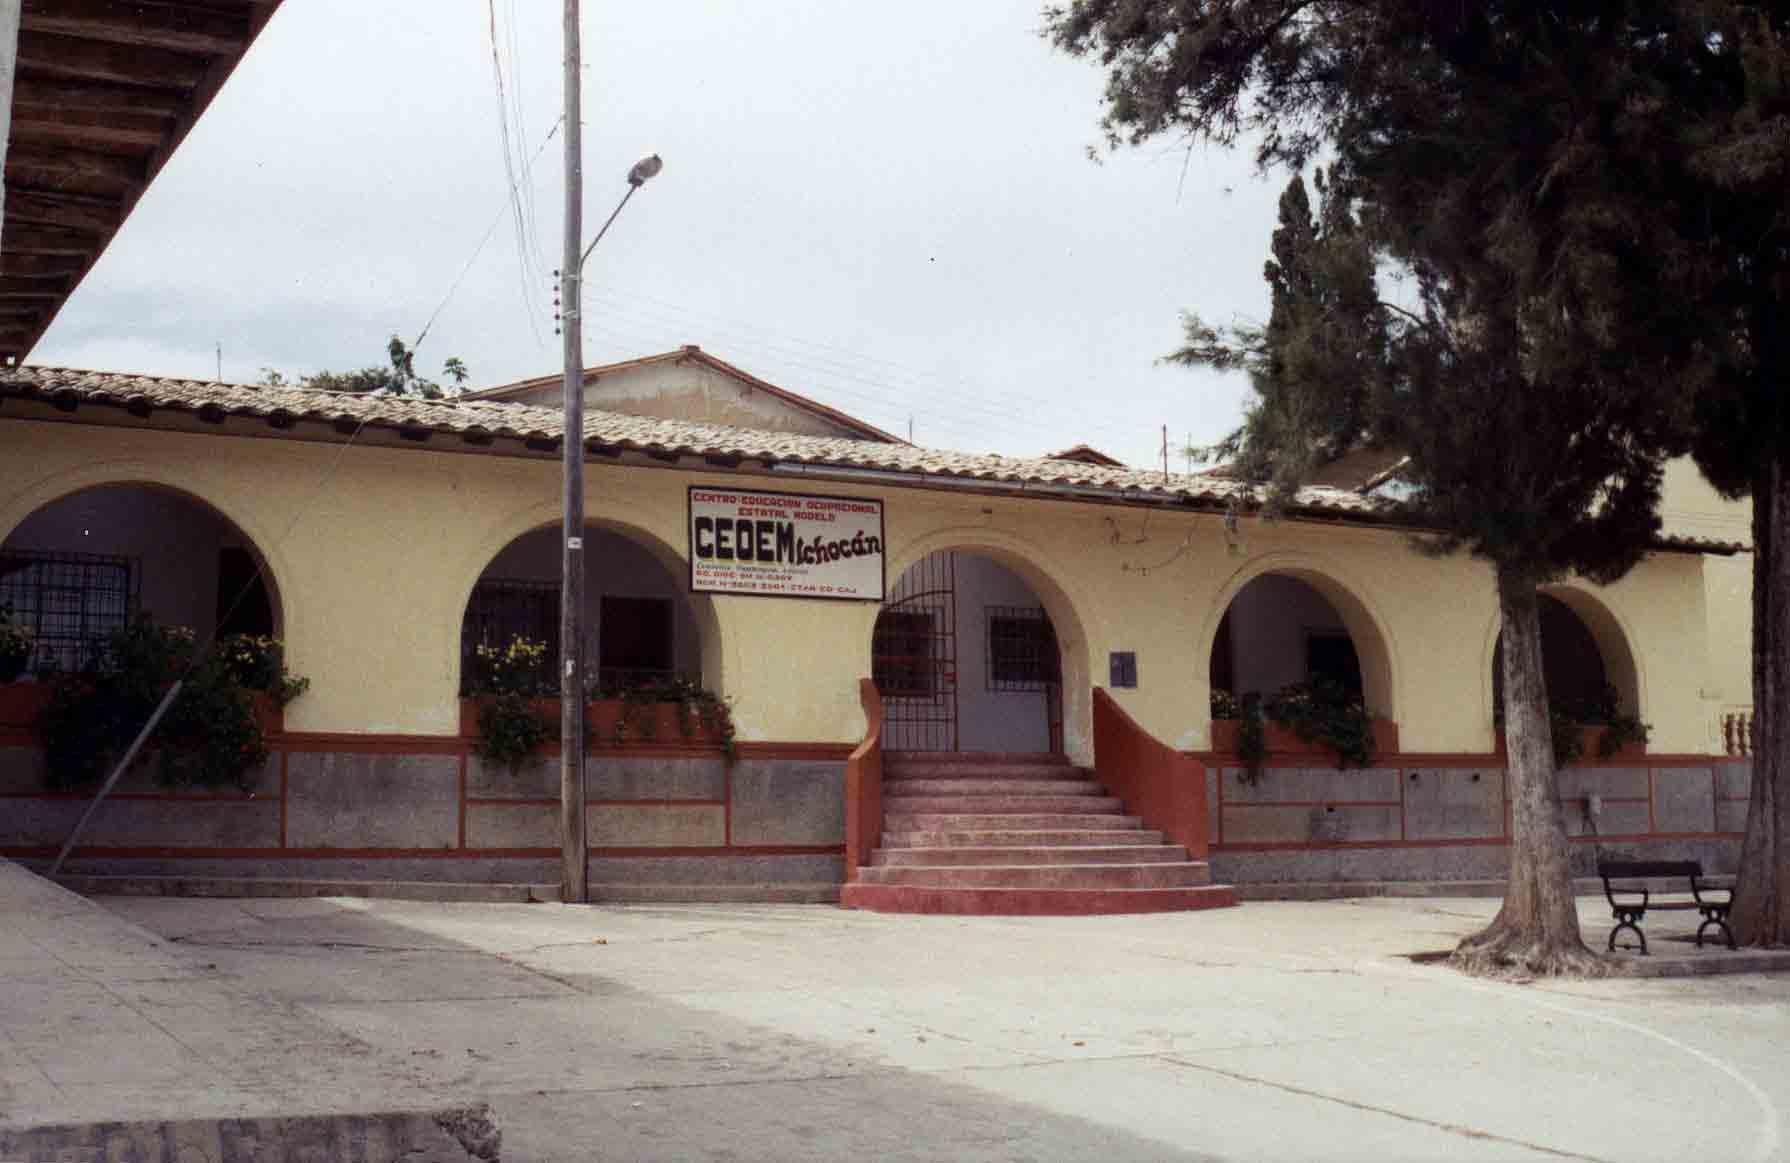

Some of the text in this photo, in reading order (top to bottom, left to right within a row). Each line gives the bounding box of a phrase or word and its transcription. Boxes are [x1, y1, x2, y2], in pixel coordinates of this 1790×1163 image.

[694, 492, 736, 504] CENTRO
[737, 507, 835, 522] ESTATAL MODELO
